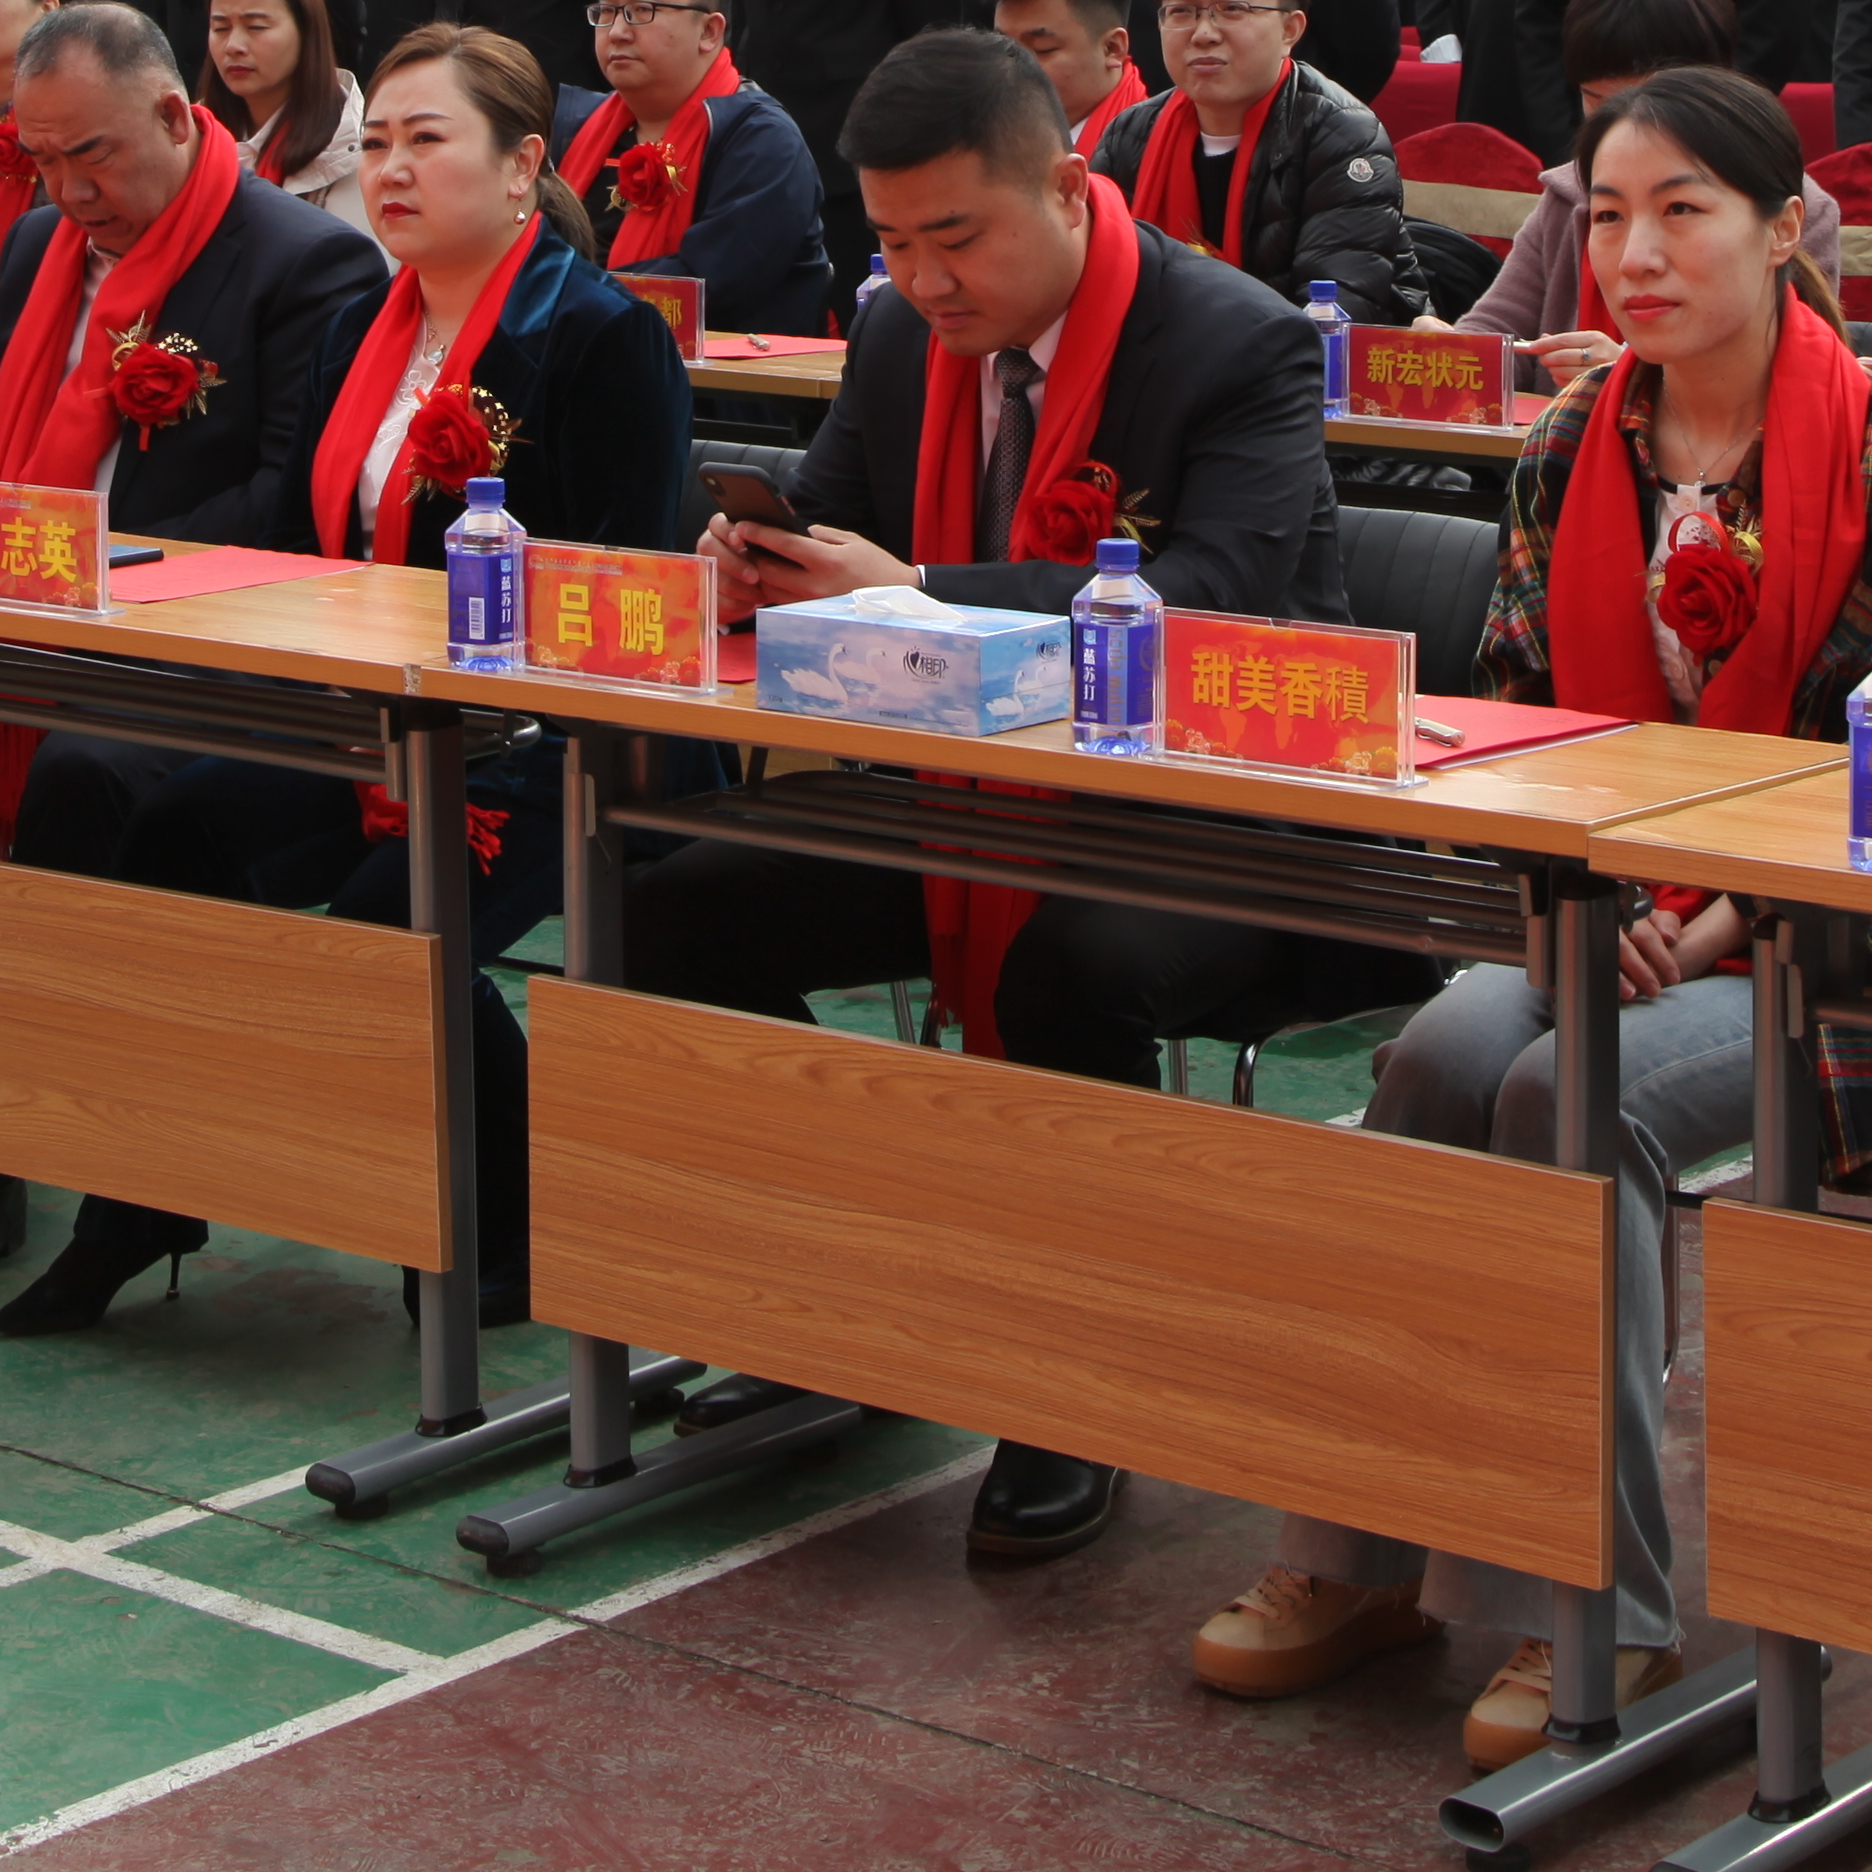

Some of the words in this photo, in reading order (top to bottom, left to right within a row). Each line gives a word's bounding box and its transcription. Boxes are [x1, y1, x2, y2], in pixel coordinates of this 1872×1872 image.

[1366, 346, 1485, 392] 新宏状元
[557, 582, 665, 657] 吕鹏
